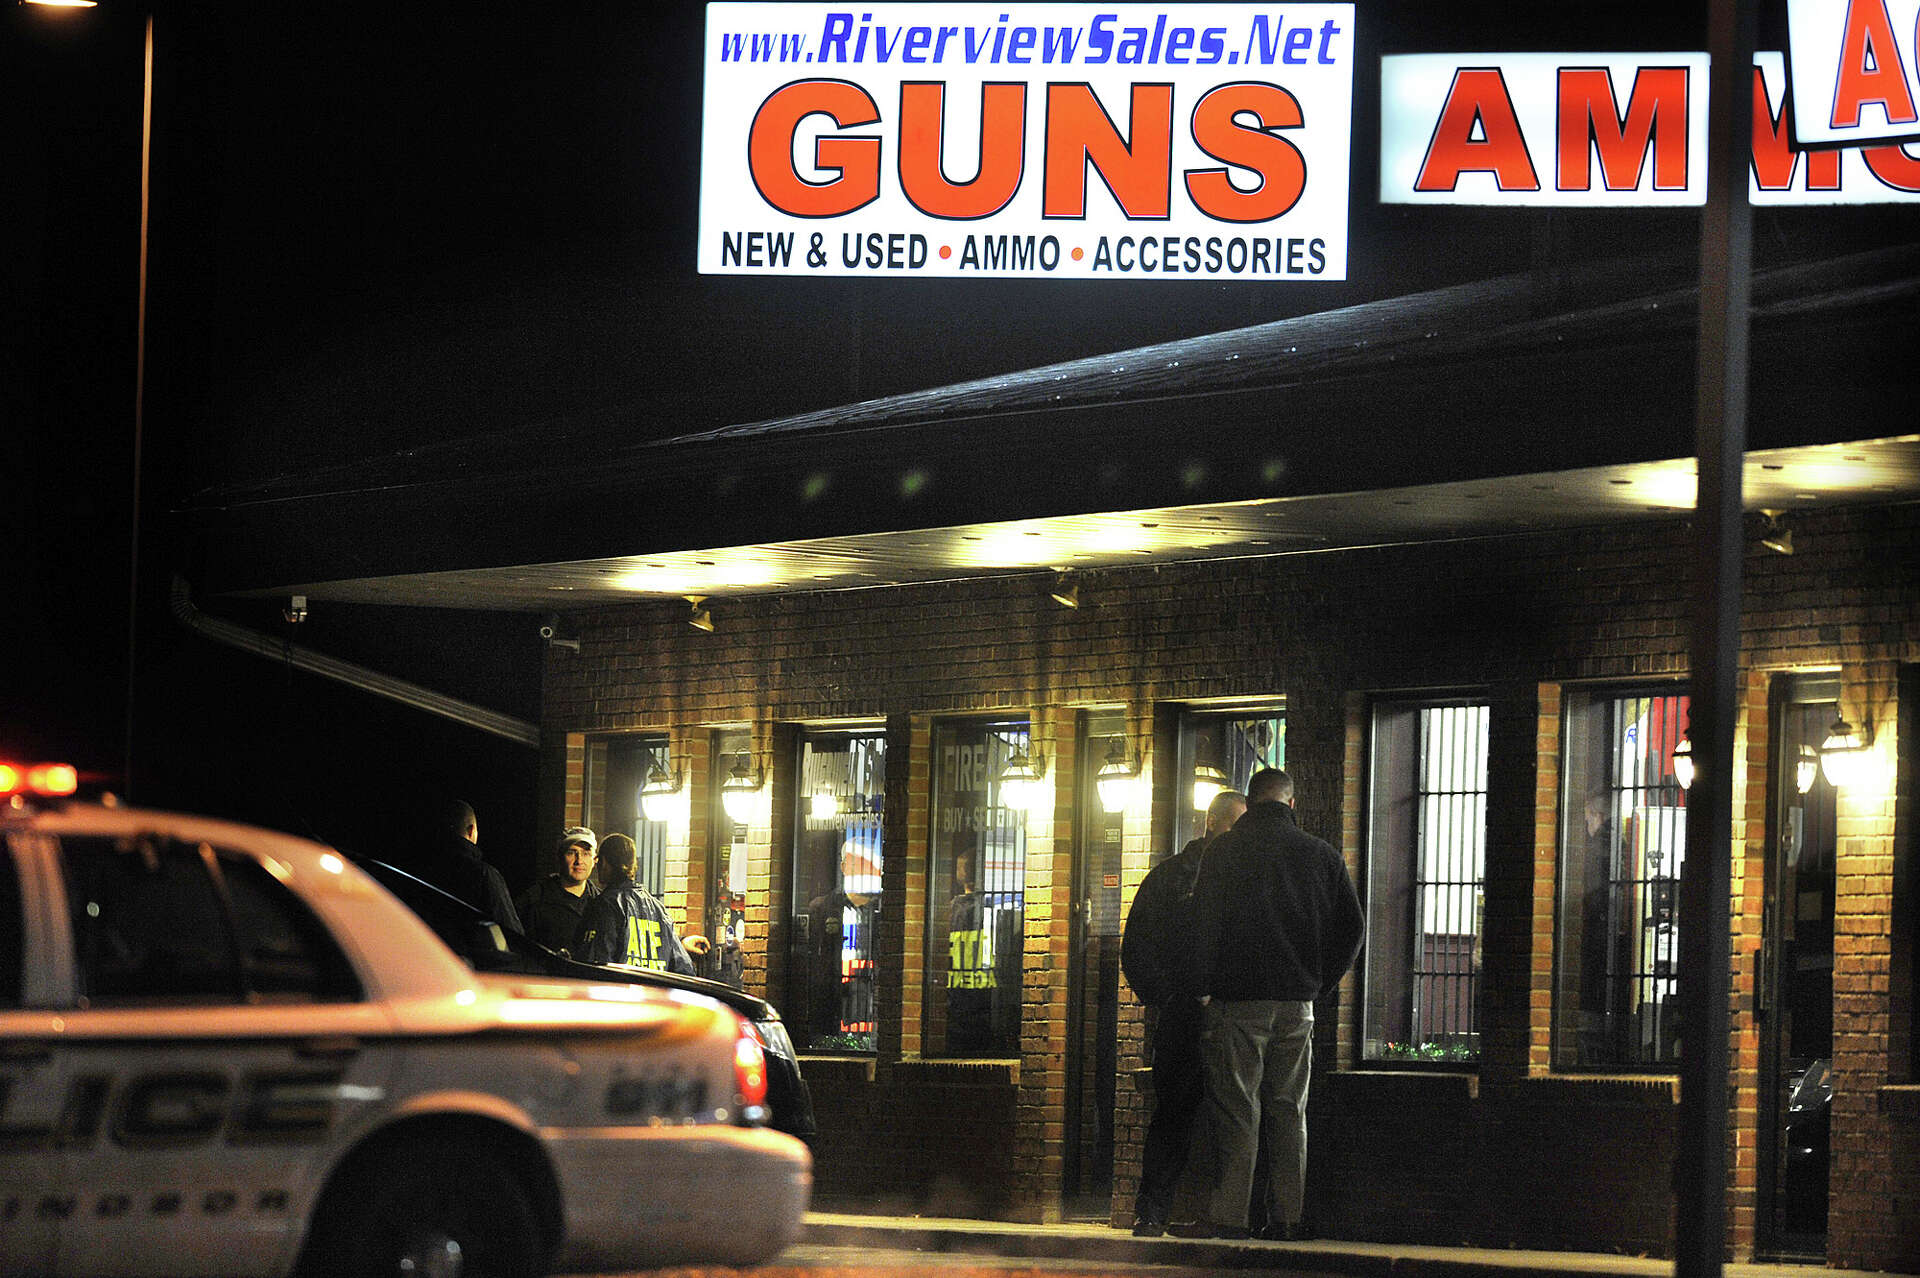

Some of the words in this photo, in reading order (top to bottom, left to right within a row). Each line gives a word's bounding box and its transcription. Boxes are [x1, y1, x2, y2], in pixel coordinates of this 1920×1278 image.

[720, 12, 1341, 65] www.RiverviewSales.Net
[747, 77, 1308, 224] GUNS
[721, 231, 795, 268] NEW
[805, 231, 828, 268] &
[841, 232, 928, 270] USED
[958, 234, 1061, 271] AMMO
[1091, 236, 1326, 275] ACCESSORIES
[627, 916, 662, 959] ATF
